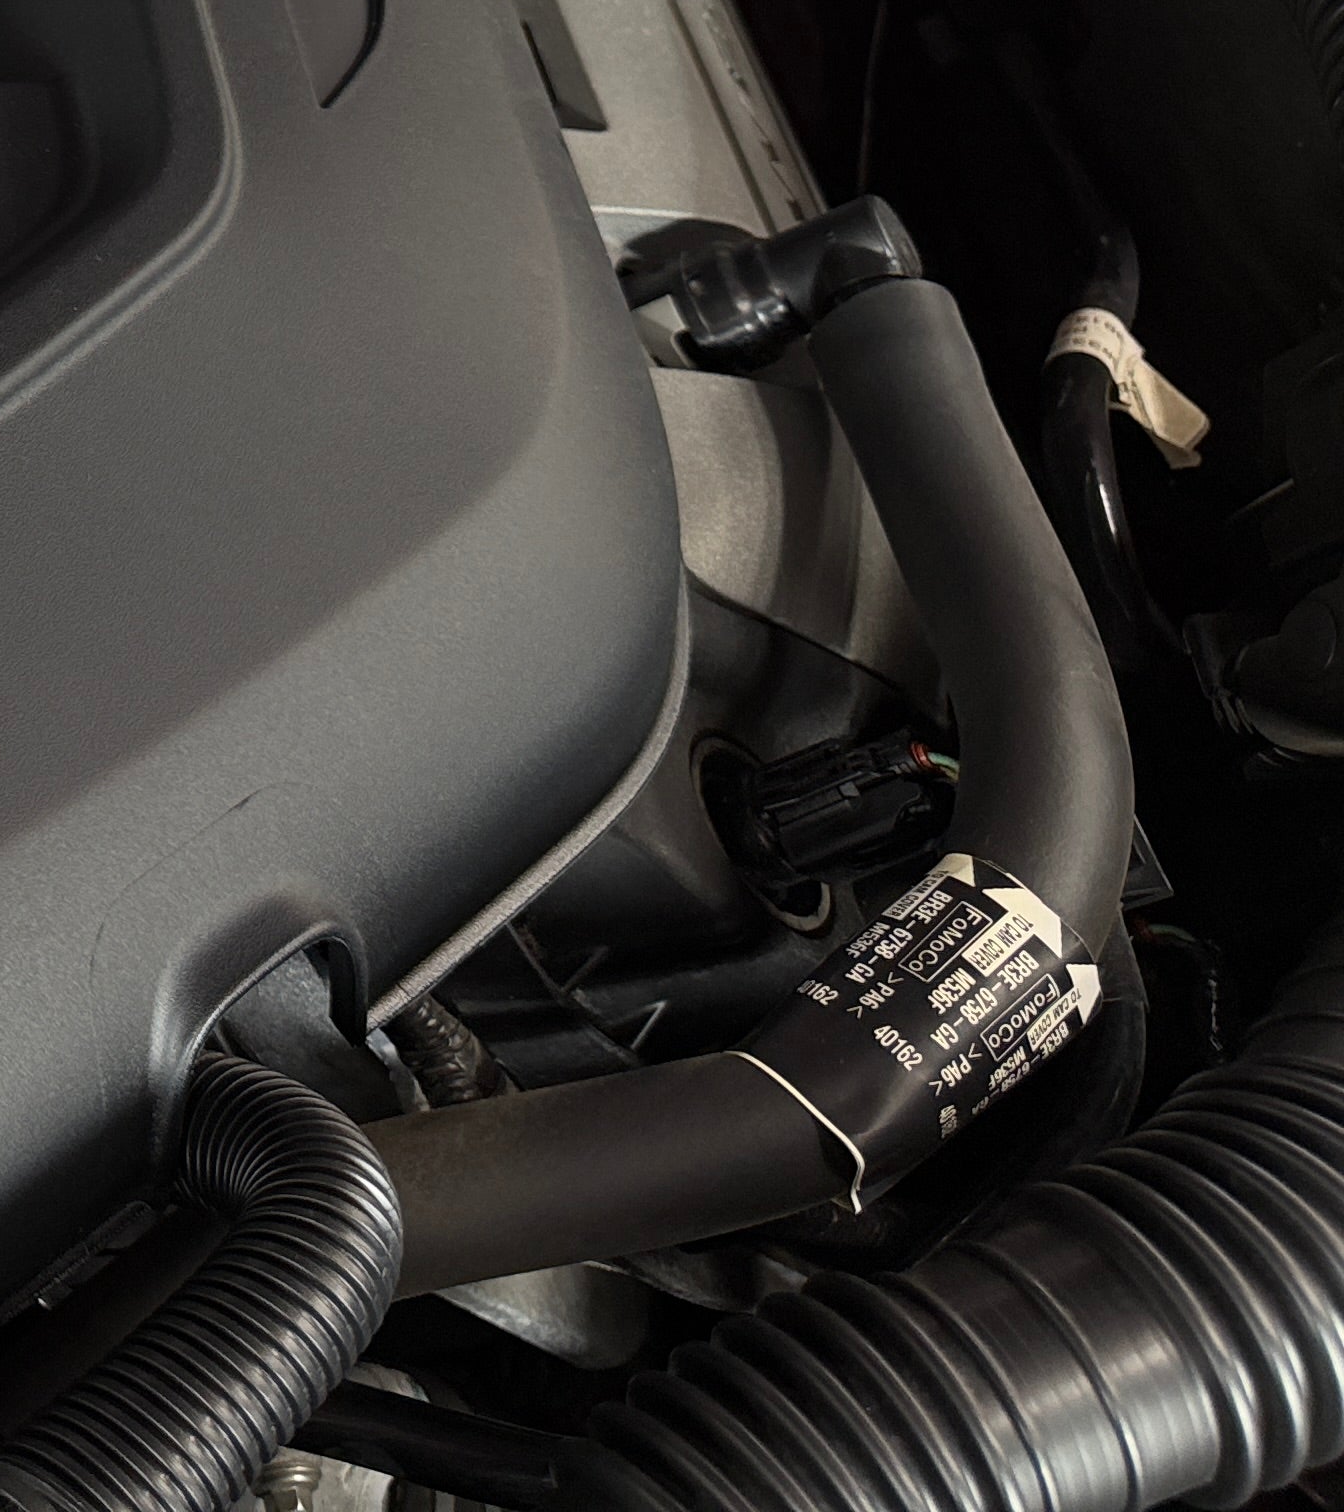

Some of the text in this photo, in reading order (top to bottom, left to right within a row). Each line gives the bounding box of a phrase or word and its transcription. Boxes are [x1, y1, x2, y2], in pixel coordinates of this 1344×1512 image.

[847, 922, 890, 958] M536F
[909, 908, 979, 972] FoMoCo
[969, 914, 1033, 970] TO CAM COVER
[928, 968, 976, 1014] M536F
[931, 950, 1039, 1049] BR3E-6758-GA
[989, 984, 1057, 1047] FoMoCo
[1026, 1014, 1051, 1045] COVER
[874, 1026, 922, 1071] 40162
[989, 1046, 1026, 1089] M536F
